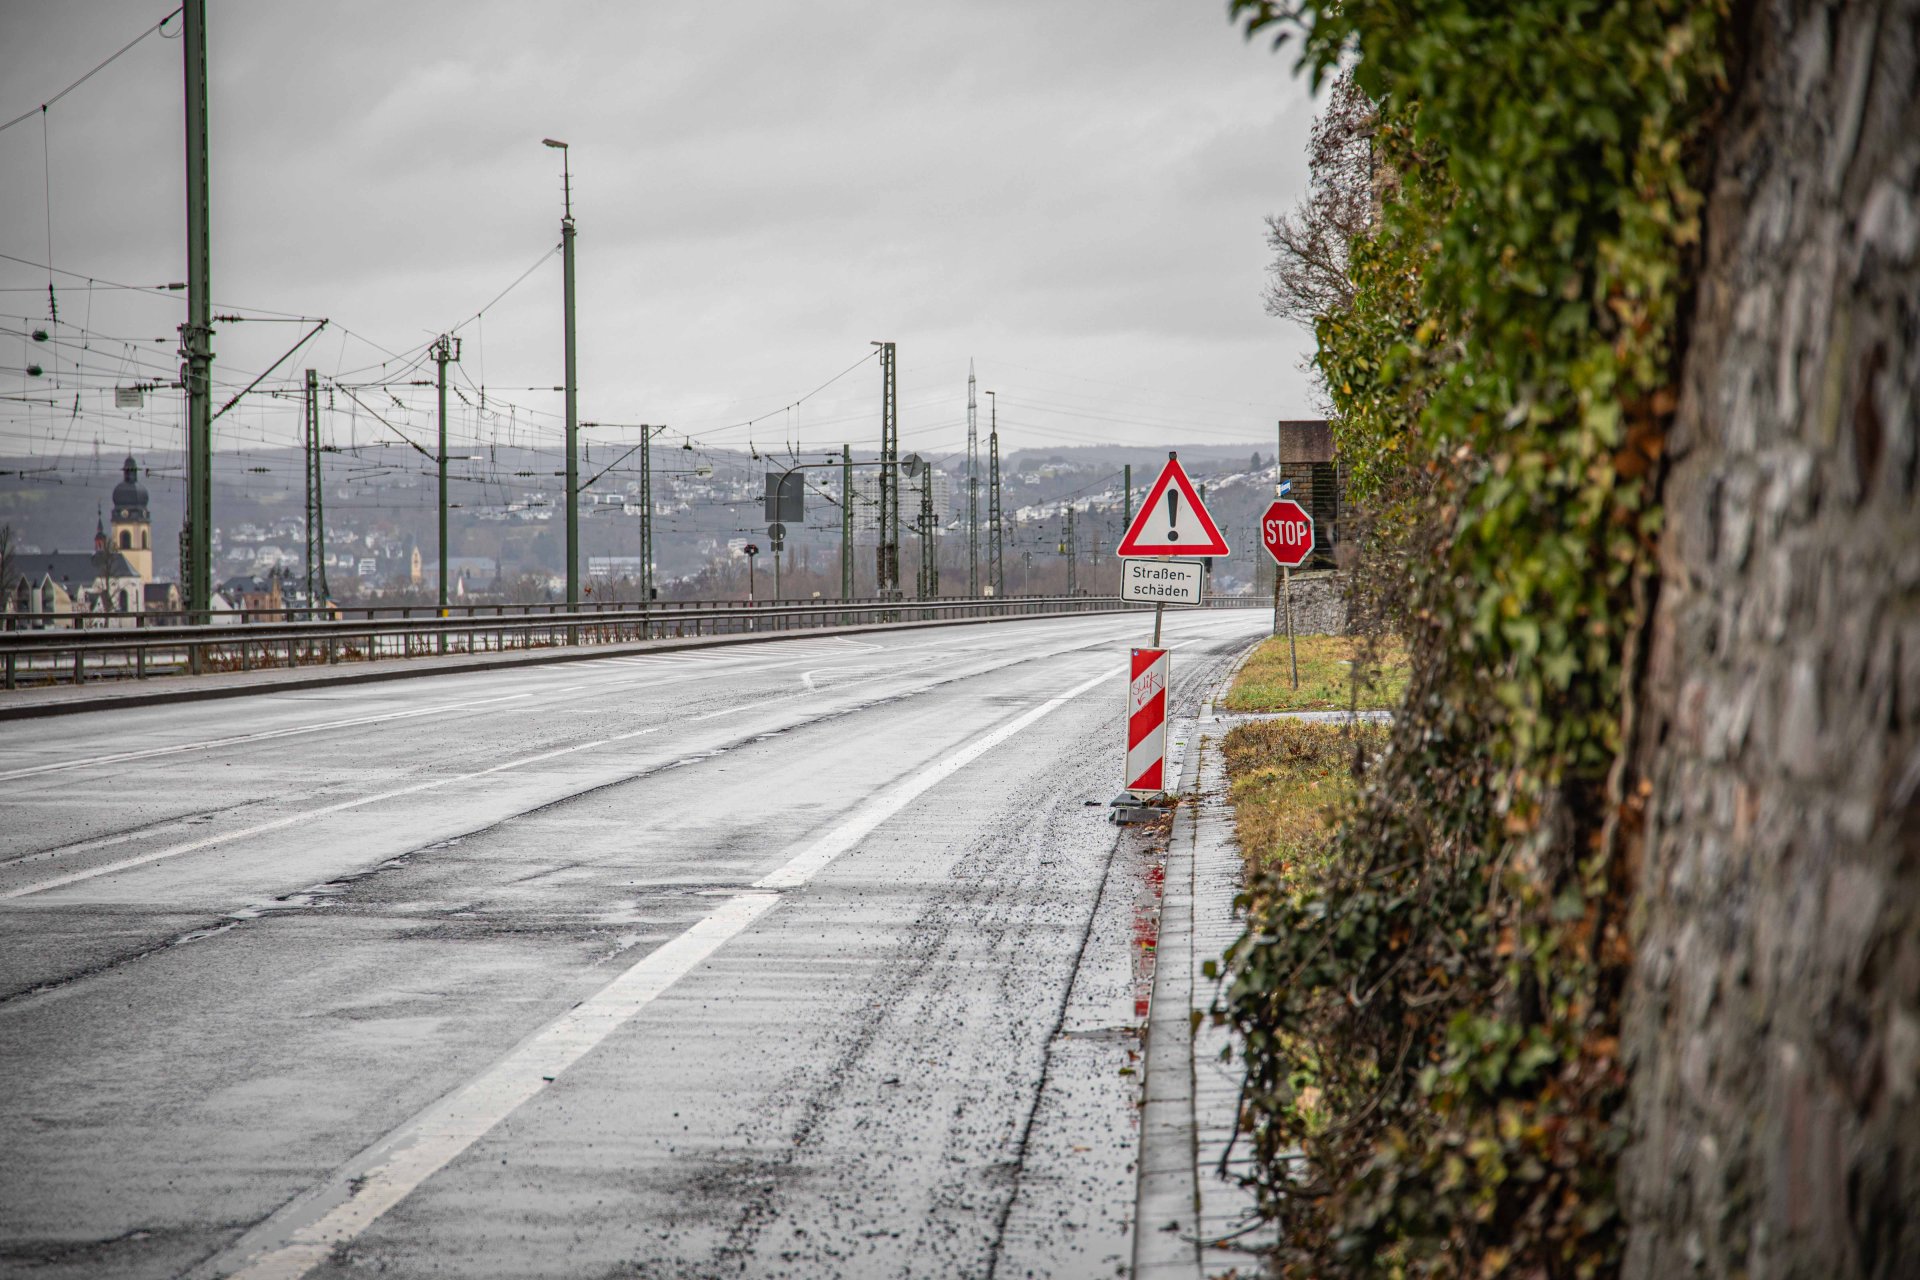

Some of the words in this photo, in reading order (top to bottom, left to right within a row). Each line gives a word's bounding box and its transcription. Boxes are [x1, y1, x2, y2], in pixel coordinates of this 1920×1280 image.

[1266, 519, 1307, 546] STOP
[1132, 566, 1191, 580] Straßen-
[1134, 583, 1188, 597] schäden
